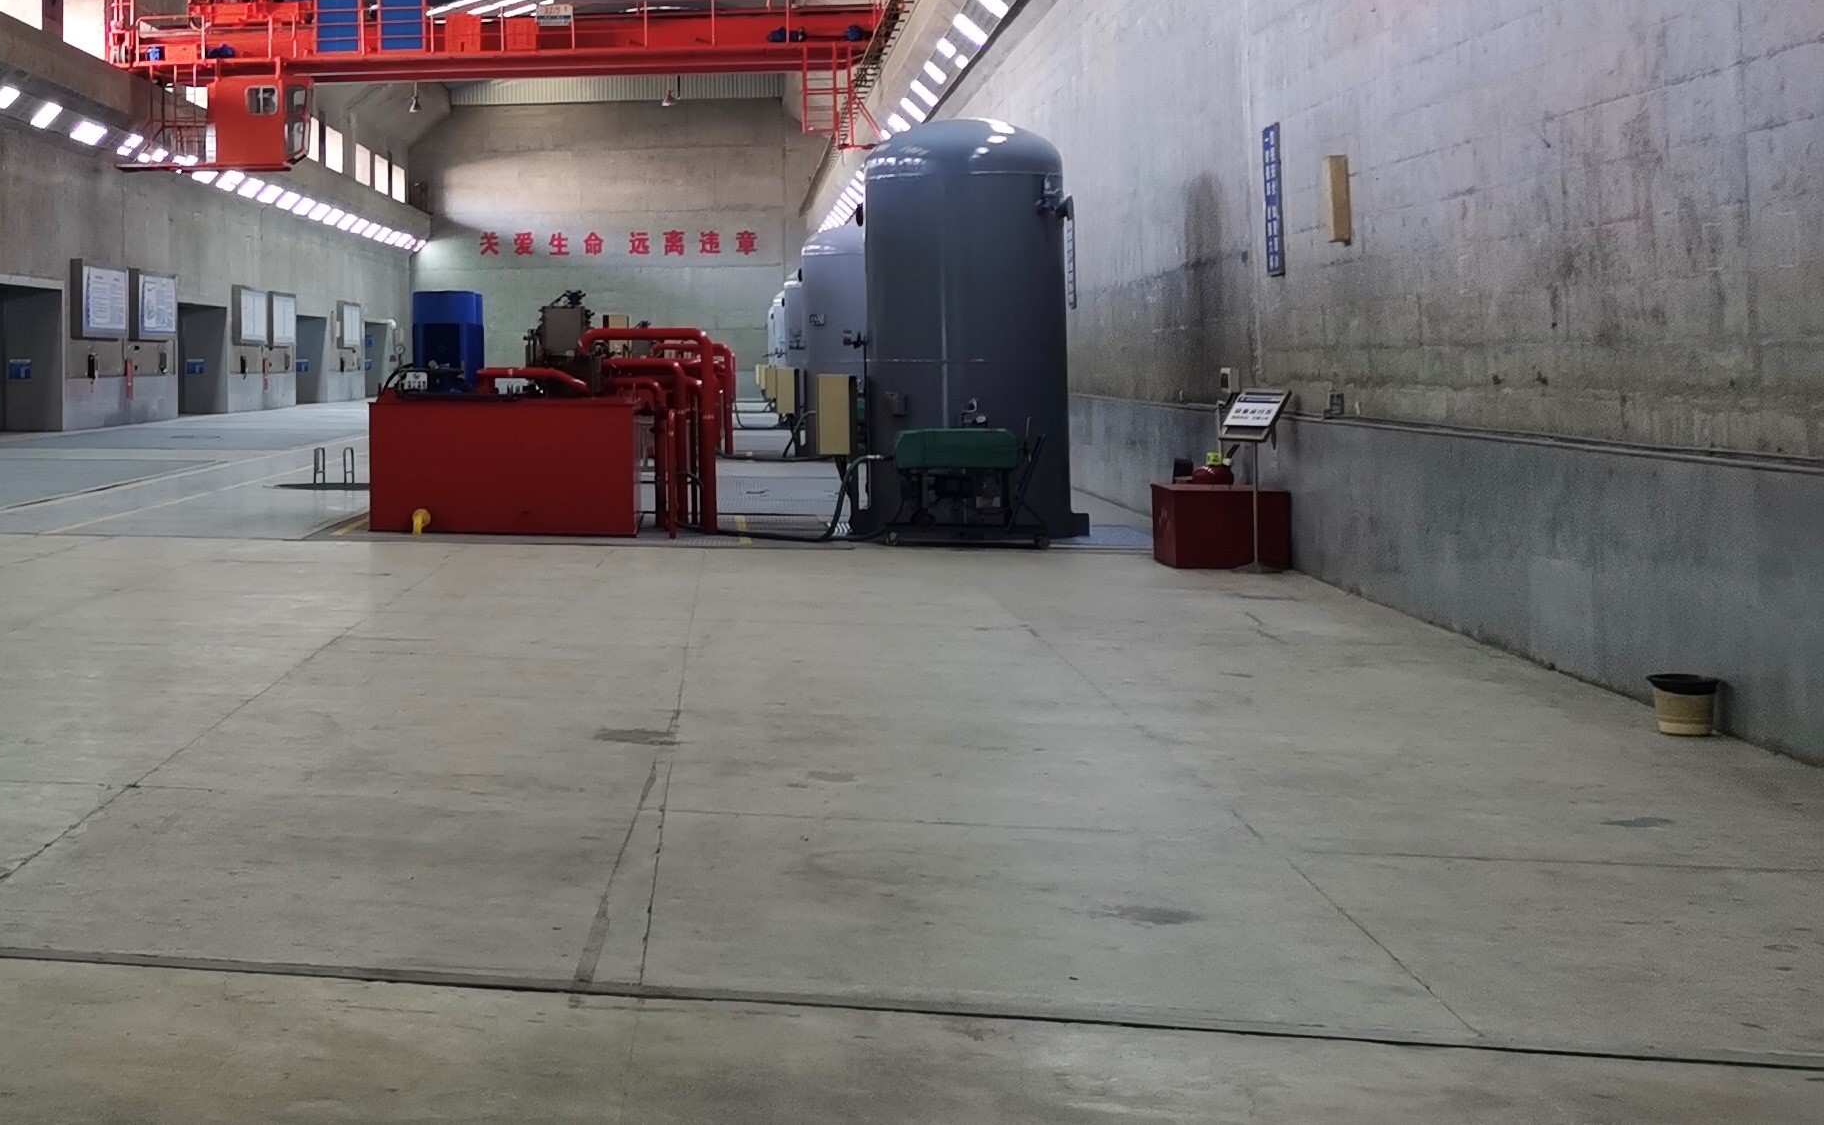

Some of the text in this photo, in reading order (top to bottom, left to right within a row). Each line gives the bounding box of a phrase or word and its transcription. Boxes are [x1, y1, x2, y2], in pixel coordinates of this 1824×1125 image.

[479, 230, 758, 256] 关爱生命 远离违章
